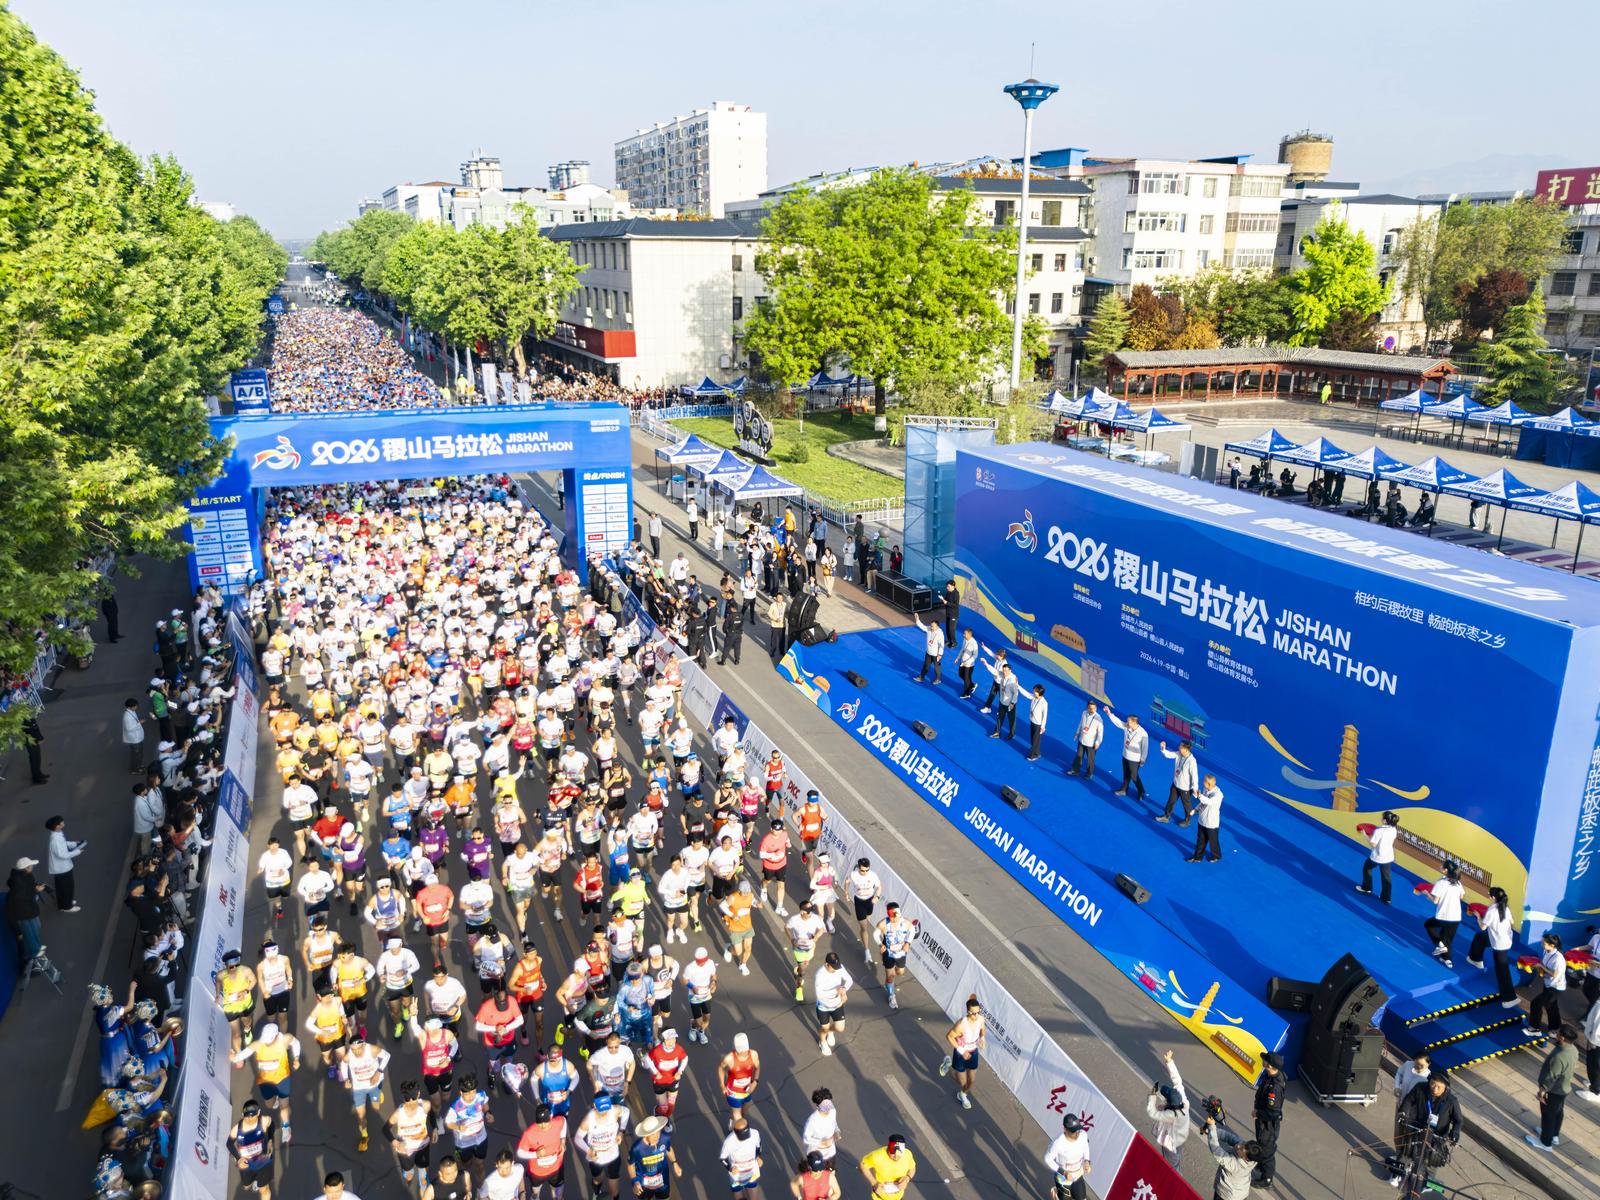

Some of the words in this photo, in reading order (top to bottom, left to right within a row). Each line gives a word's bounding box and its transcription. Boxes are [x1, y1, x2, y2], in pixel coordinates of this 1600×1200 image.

[237, 387, 264, 398] A/B
[505, 432, 549, 444] JISHAN
[506, 441, 574, 455] MARATHON
[1275, 609, 1351, 651] JISHAN
[1354, 590, 1424, 625] 相约后稷故里
[1427, 612, 1506, 649] 畅跑板枣之乡
[1272, 631, 1398, 696] MARATHON
[964, 806, 1015, 853] JISHAN
[1011, 843, 1102, 927] MARATHON
[921, 931, 953, 970] 中煤保险
